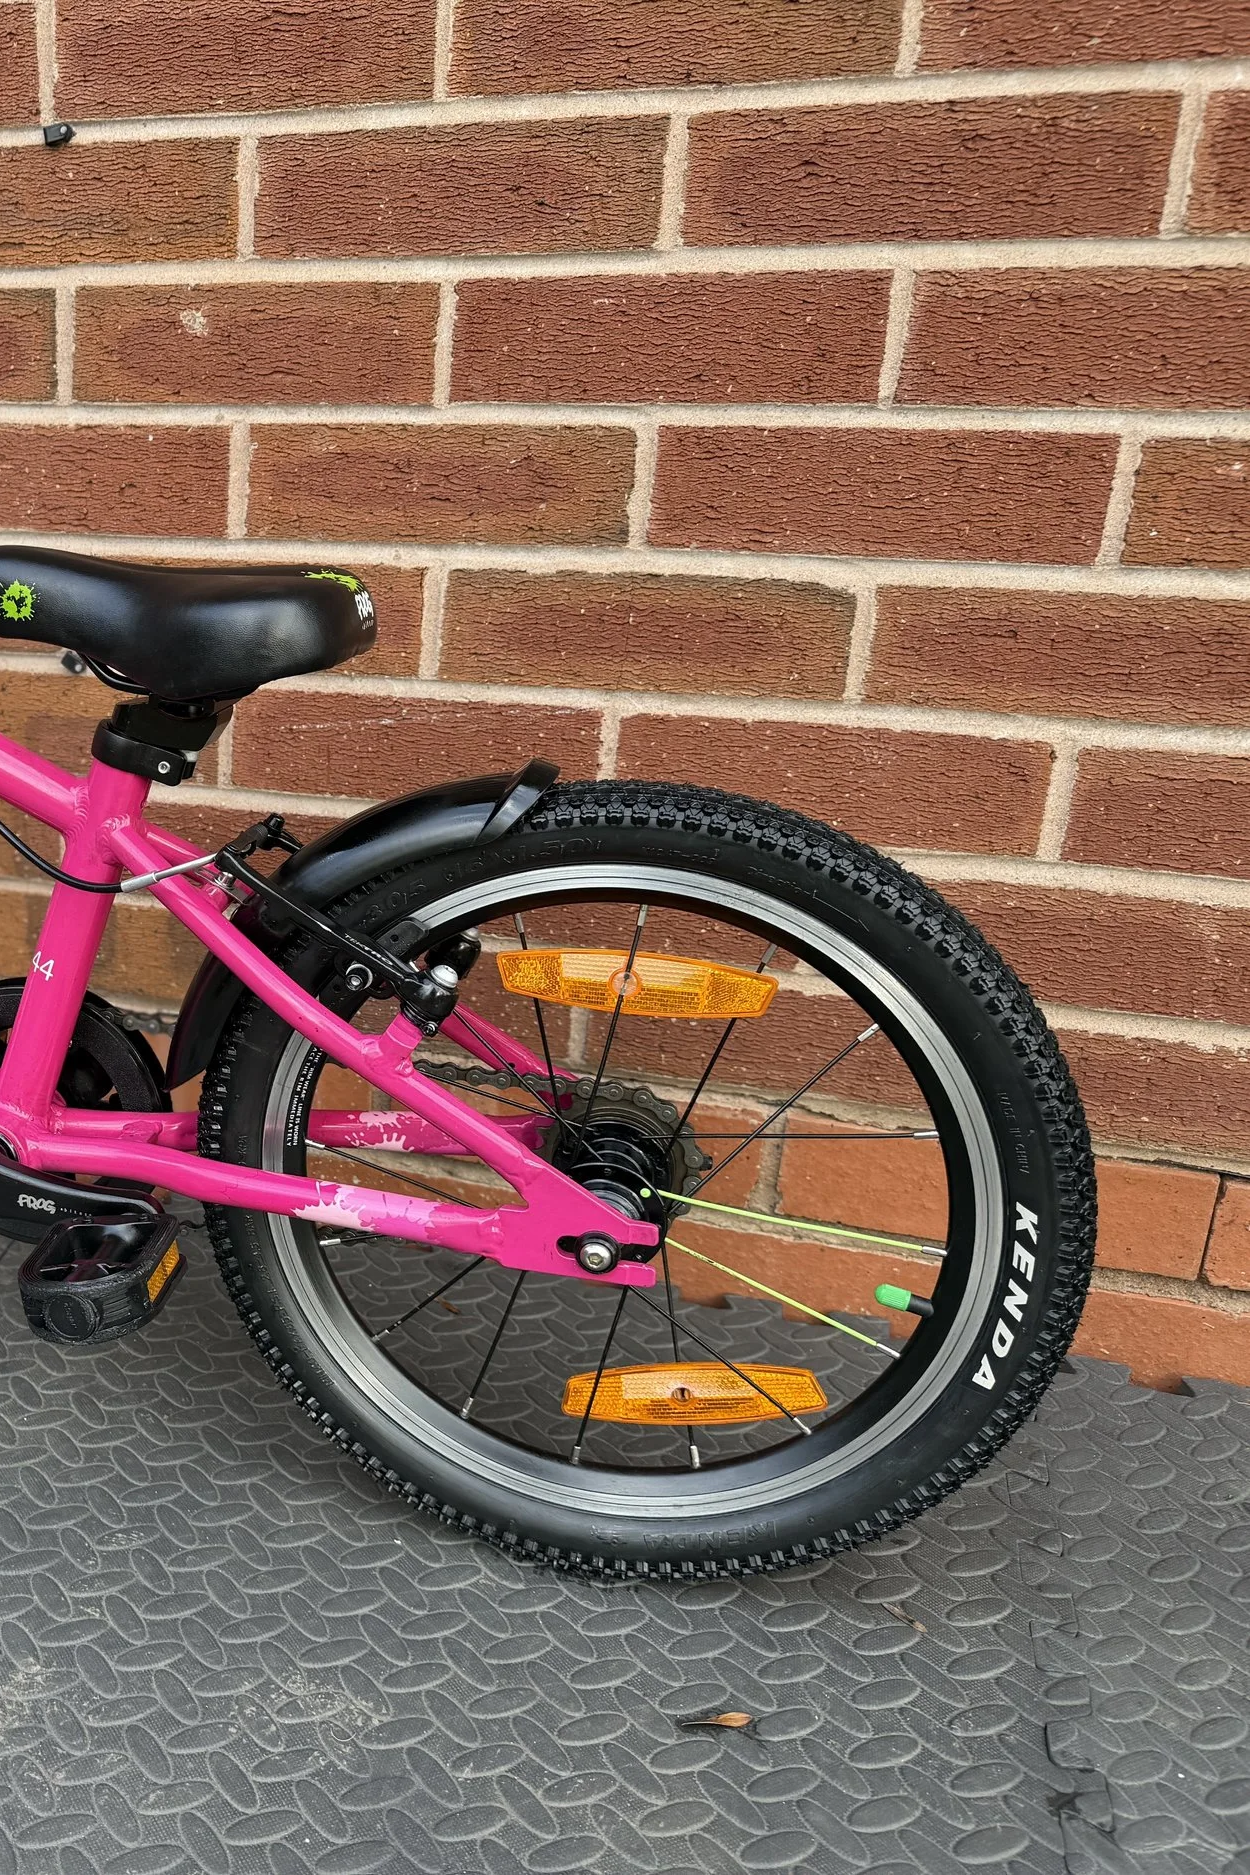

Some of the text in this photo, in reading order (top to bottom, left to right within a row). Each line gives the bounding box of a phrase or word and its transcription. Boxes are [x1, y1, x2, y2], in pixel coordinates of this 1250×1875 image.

[32, 950, 54, 981] 44
[286, 1062, 311, 1147] THE RIM IMMEDIATELY
[17, 1193, 56, 1214] FROG
[971, 1201, 1038, 1391] KENDA
